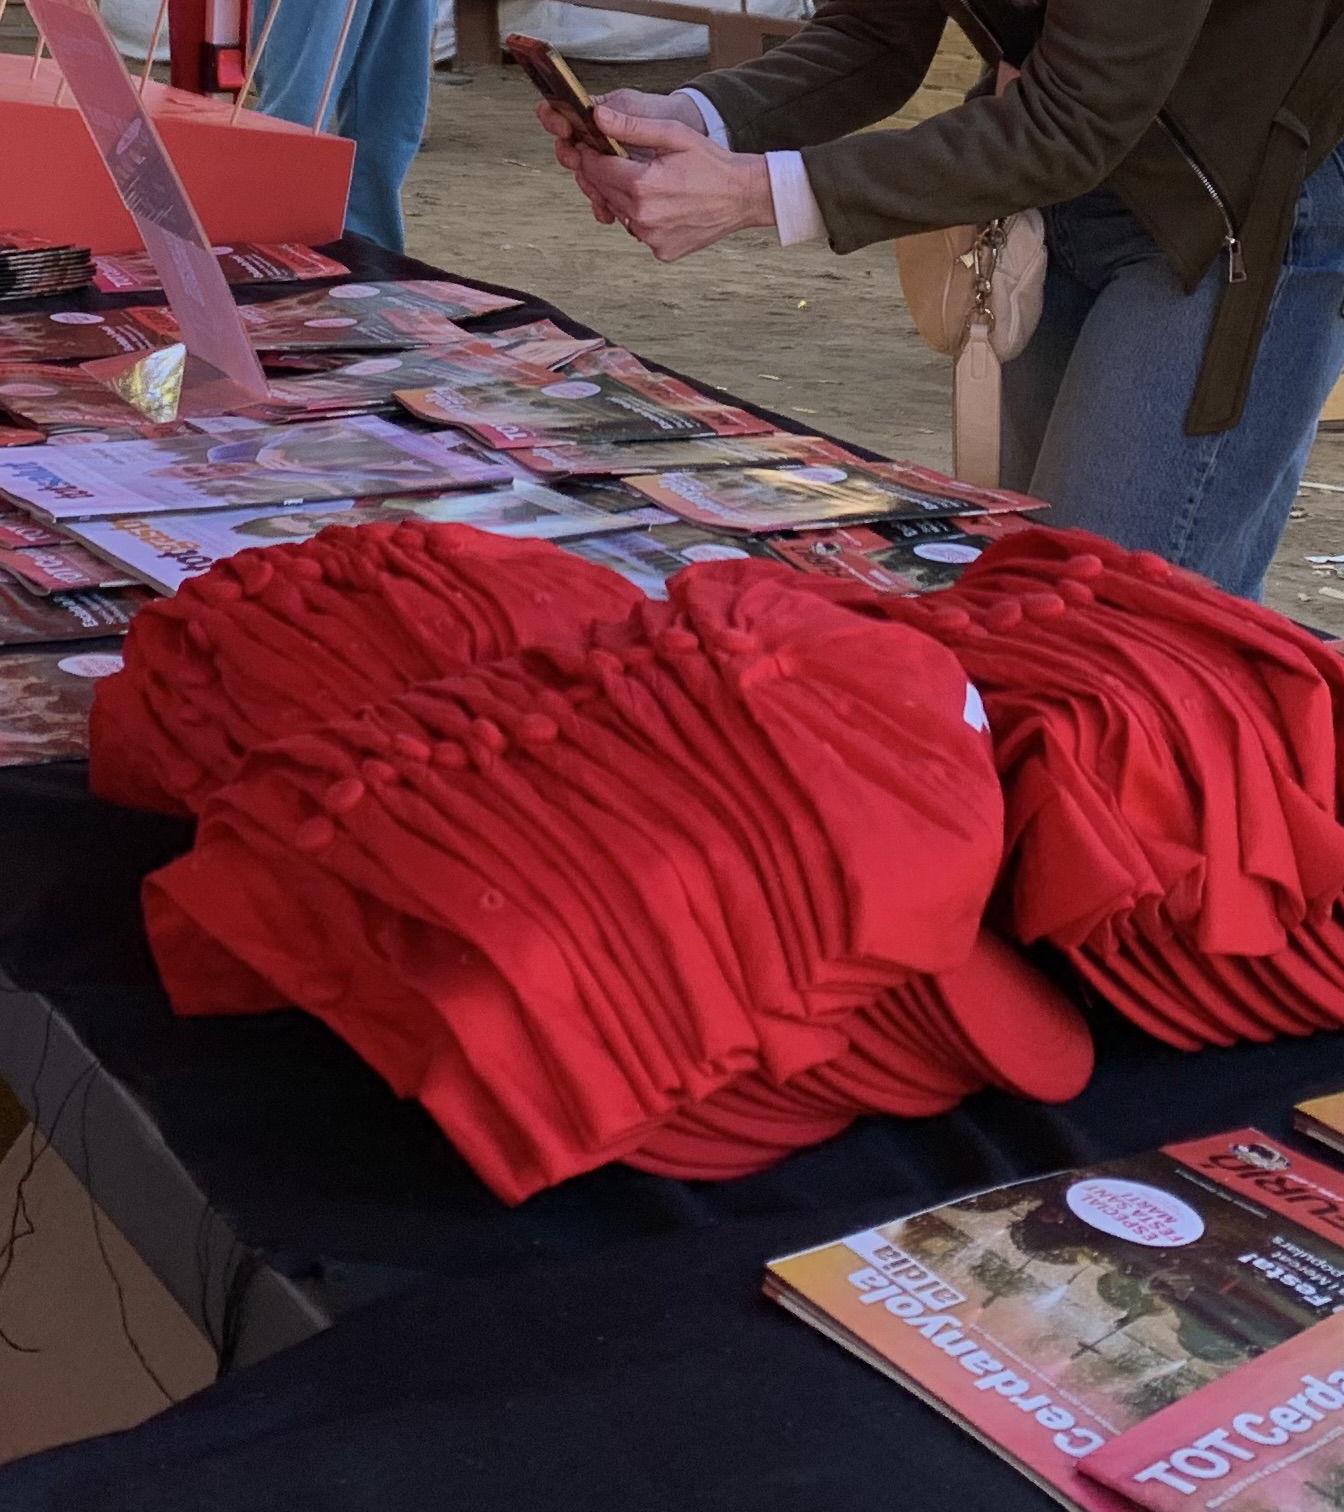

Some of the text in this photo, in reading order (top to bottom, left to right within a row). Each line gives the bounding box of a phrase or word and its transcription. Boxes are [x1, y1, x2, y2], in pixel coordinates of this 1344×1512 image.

[1080, 1195, 1158, 1244] ESPECIAL
[1131, 1202, 1186, 1243] FESTA
[1236, 1253, 1333, 1306] Festa!
[848, 1266, 1106, 1459] Cerdanyola
[1133, 1426, 1255, 1495] TOT
